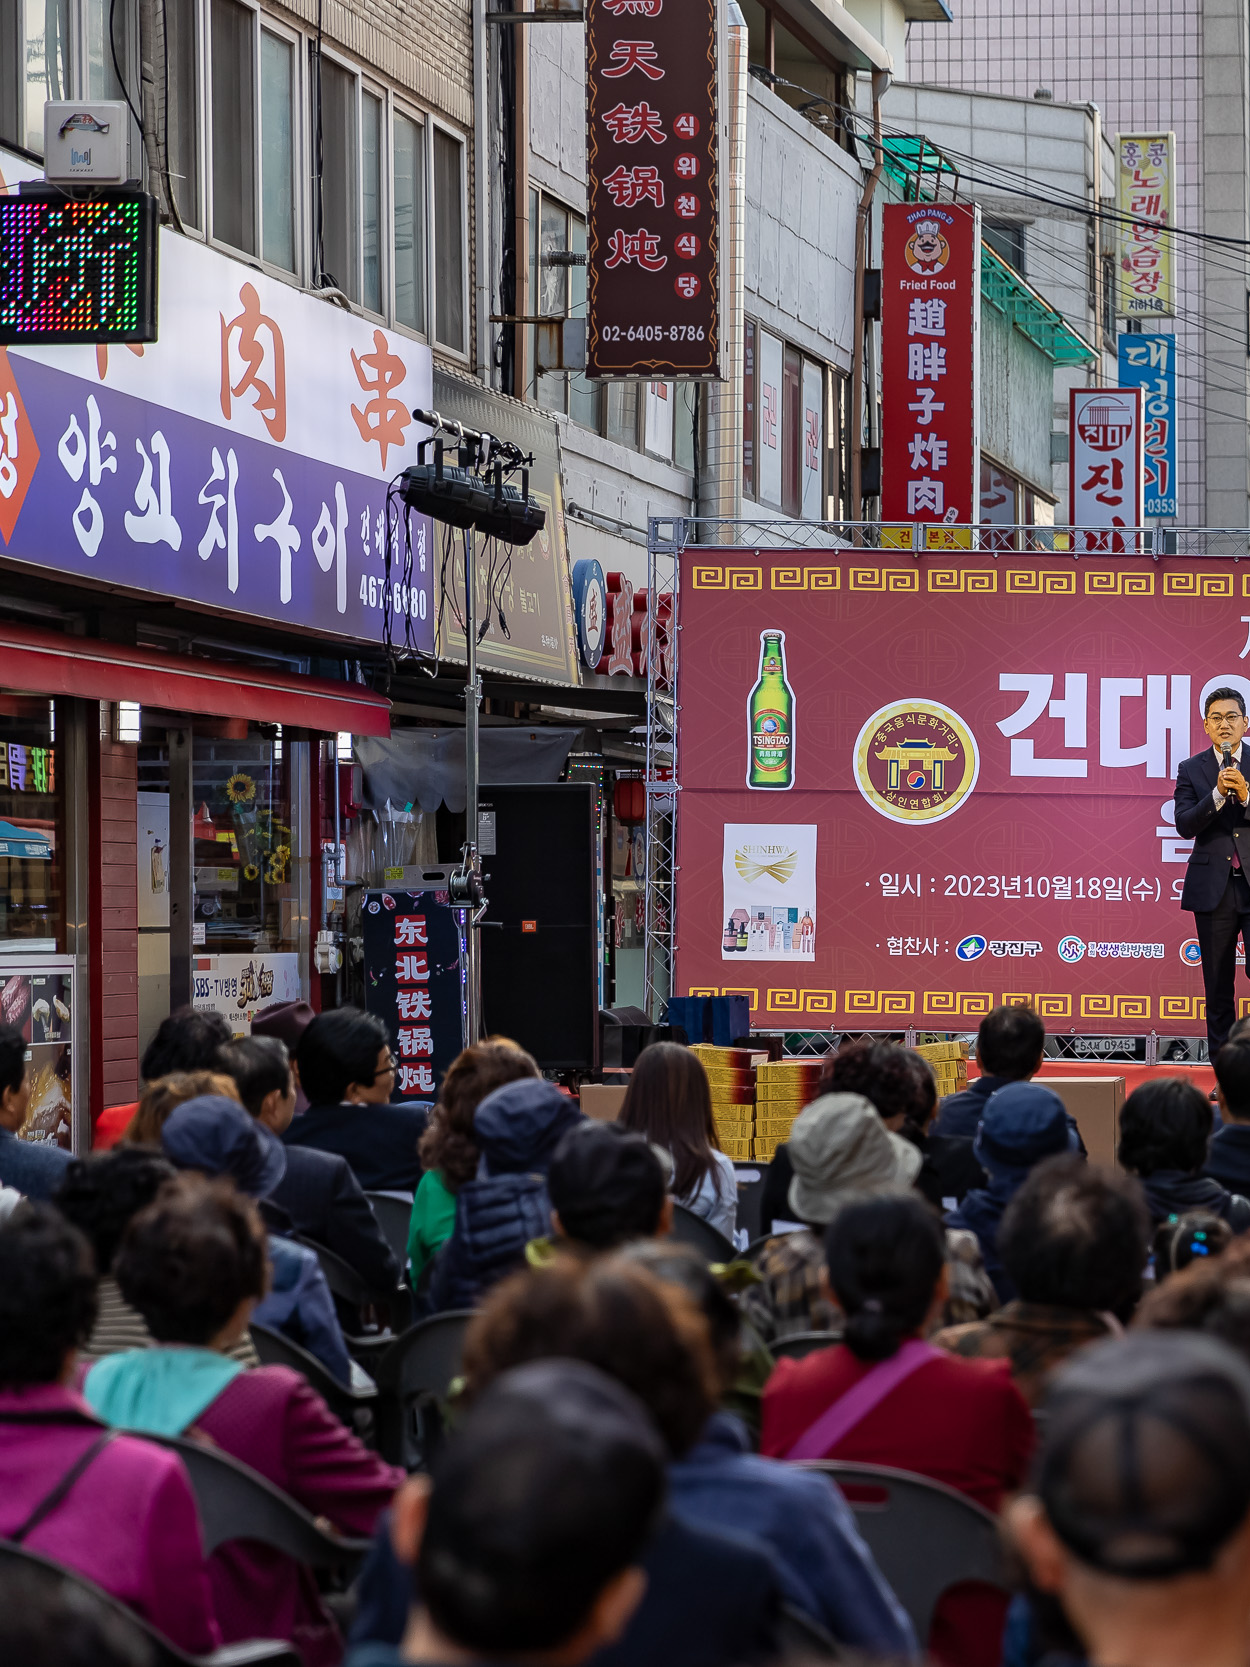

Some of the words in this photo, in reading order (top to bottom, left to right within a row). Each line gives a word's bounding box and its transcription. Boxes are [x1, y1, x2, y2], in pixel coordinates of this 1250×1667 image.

[1121, 142, 1167, 167] 홍콩
[676, 113, 698, 298] 식위천식당
[907, 210, 926, 224] ZHAO
[927, 208, 944, 219] PANG
[900, 279, 927, 291] Fried
[930, 279, 956, 291] Food
[602, 325, 705, 342] 02-6405-8786
[907, 298, 948, 515] 趙胖子炸肉
[1085, 426, 1127, 447] 진미
[57, 394, 349, 614] 양꼬치구이
[876, 713, 958, 743] 중국음식문화거리
[753, 735, 790, 745] TSINGTAO
[887, 792, 944, 810] 상인연합회
[743, 844, 790, 855] SHINHWA
[879, 873, 922, 898] 일시
[943, 875, 1162, 902] 2023년10월18일(수)
[886, 935, 939, 956] 협찬사
[989, 941, 1043, 959] 광진구
[1097, 941, 1165, 959] 생생한방병원
[196, 977, 238, 998] SBS-TV방영
[394, 917, 436, 1093] 东北铁锅炖
